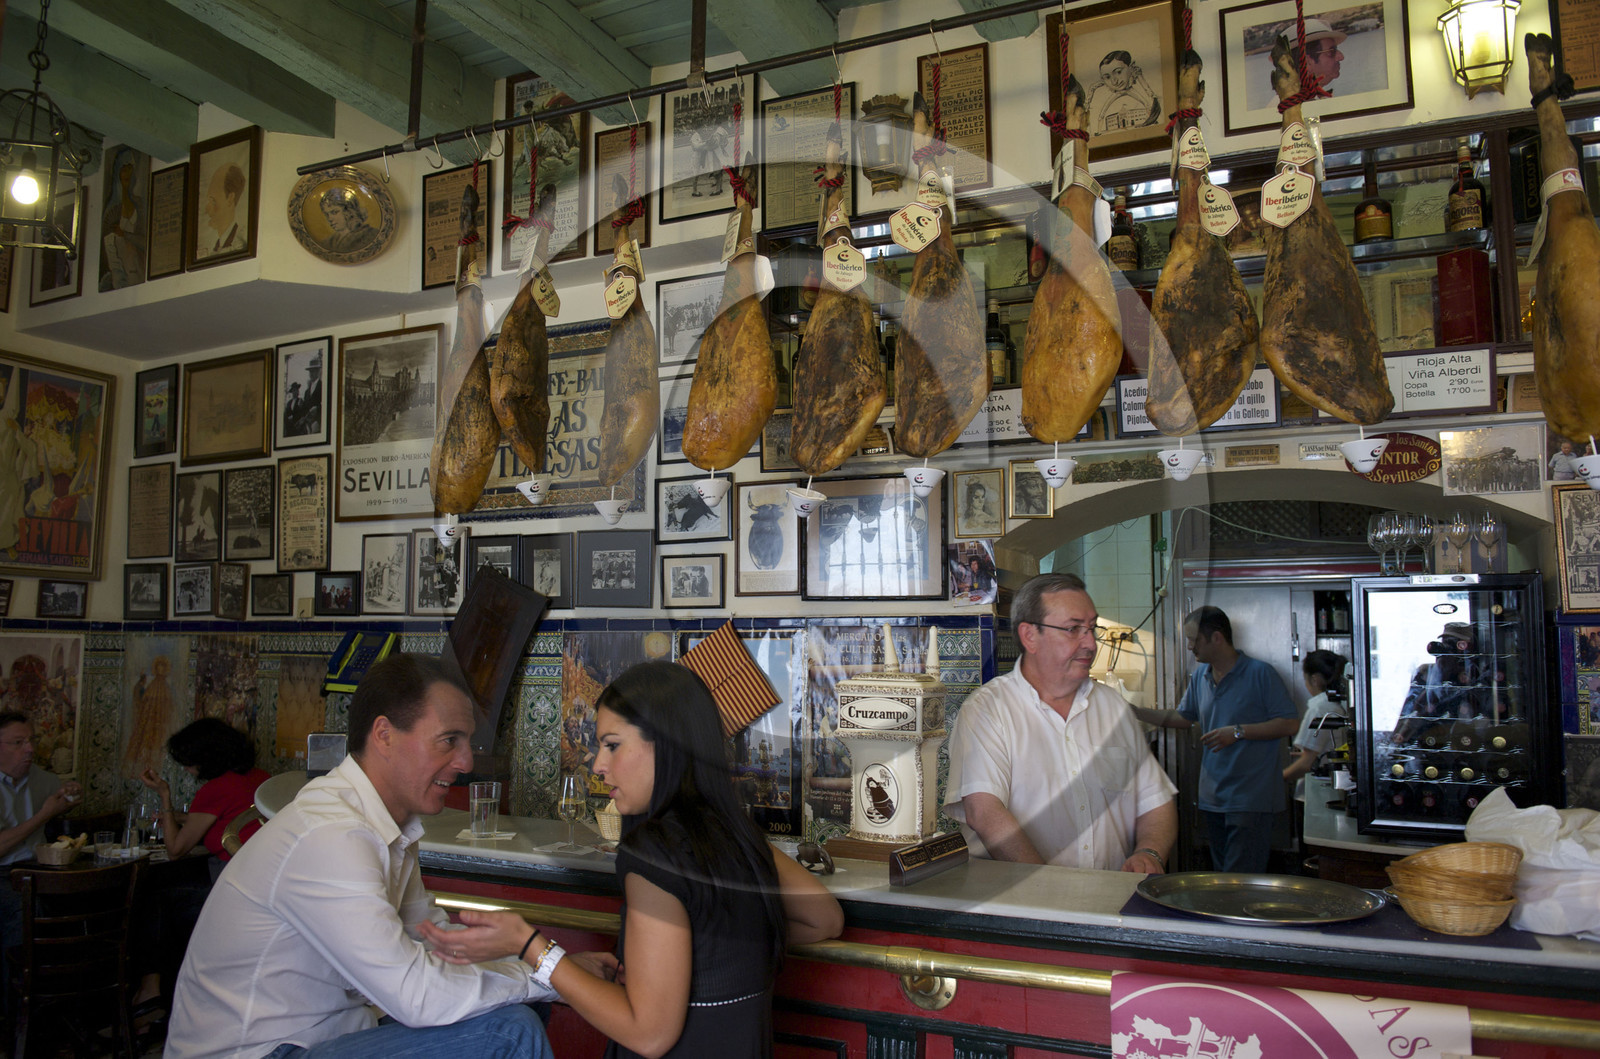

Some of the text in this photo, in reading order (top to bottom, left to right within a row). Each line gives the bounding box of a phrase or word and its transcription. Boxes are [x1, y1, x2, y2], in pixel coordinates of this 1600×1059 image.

[942, 94, 983, 107] GONZALEZ
[942, 114, 984, 127] CABAÑERO
[947, 120, 985, 132] ONZALEZ
[954, 127, 984, 137] PUERTA
[1277, 211, 1296, 219] Bellota
[1417, 355, 1472, 367] Rioja Alta
[1408, 365, 1481, 379] Viña Alberdi
[1404, 382, 1428, 391] Copa
[1449, 378, 1468, 386] 2'90
[1406, 390, 1436, 398] Botella
[1446, 387, 1471, 395] 17'00
[1238, 394, 1266, 406] al ajillo
[1233, 409, 1240, 419] la
[1242, 407, 1270, 420] Gallega
[1395, 435, 1408, 445] los
[1411, 435, 1438, 457] Santos
[343, 457, 378, 466] EXPOSICION
[401, 453, 431, 461] AMERICAN
[1380, 451, 1420, 466] INTOR
[343, 467, 430, 493] SEVILLA
[1373, 468, 1418, 484] Sevilla
[16, 517, 89, 556] SEVILLA
[836, 632, 881, 642] MERCADO
[840, 644, 885, 654] CULTURAS
[848, 706, 908, 722] Cruzcampo
[769, 822, 791, 833] 2009
